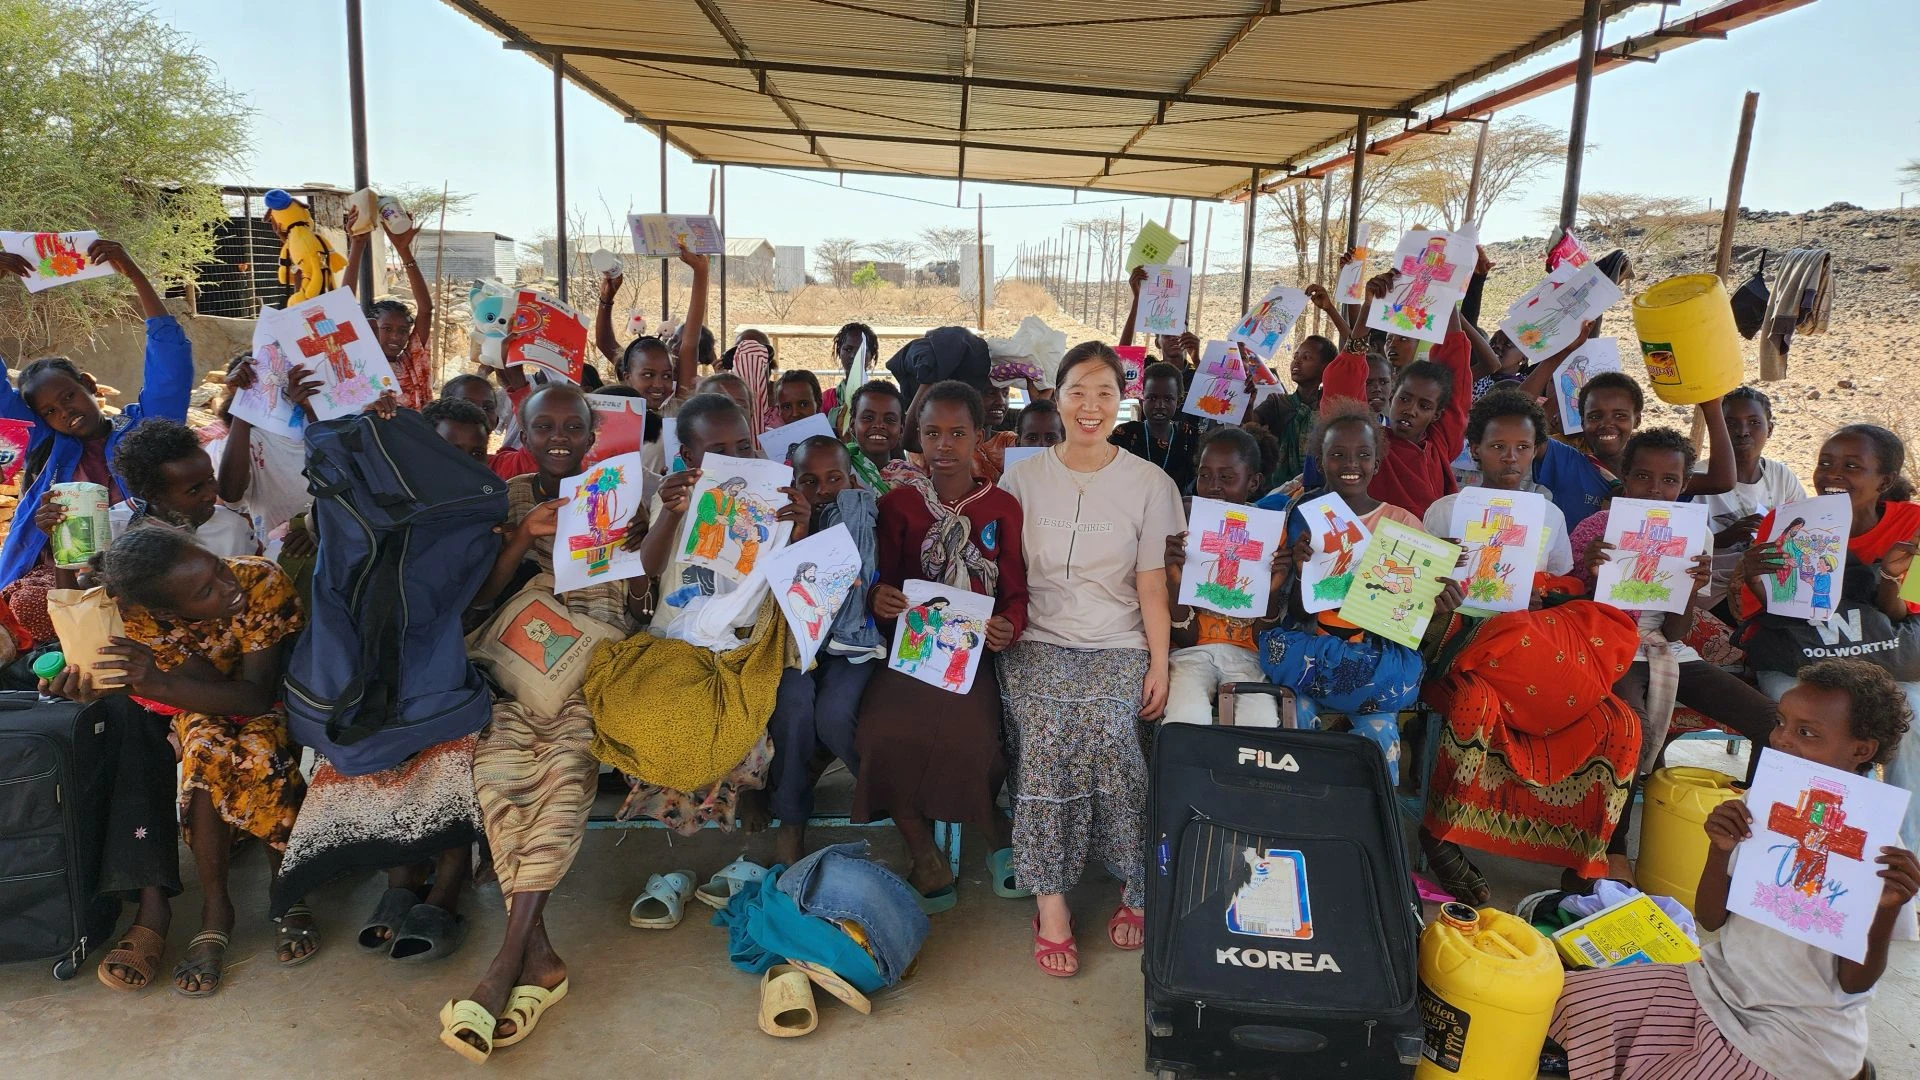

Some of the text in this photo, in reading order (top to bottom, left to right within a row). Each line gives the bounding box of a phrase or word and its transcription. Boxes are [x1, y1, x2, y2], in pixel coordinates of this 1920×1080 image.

[1038, 517, 1113, 532] JESUS CHRIST
[1802, 638, 1899, 658] OOLWORTHS
[550, 662, 568, 682] SAD
[567, 646, 583, 664] BUT
[1238, 747, 1300, 772] FILA
[1216, 947, 1342, 973] KOREA
